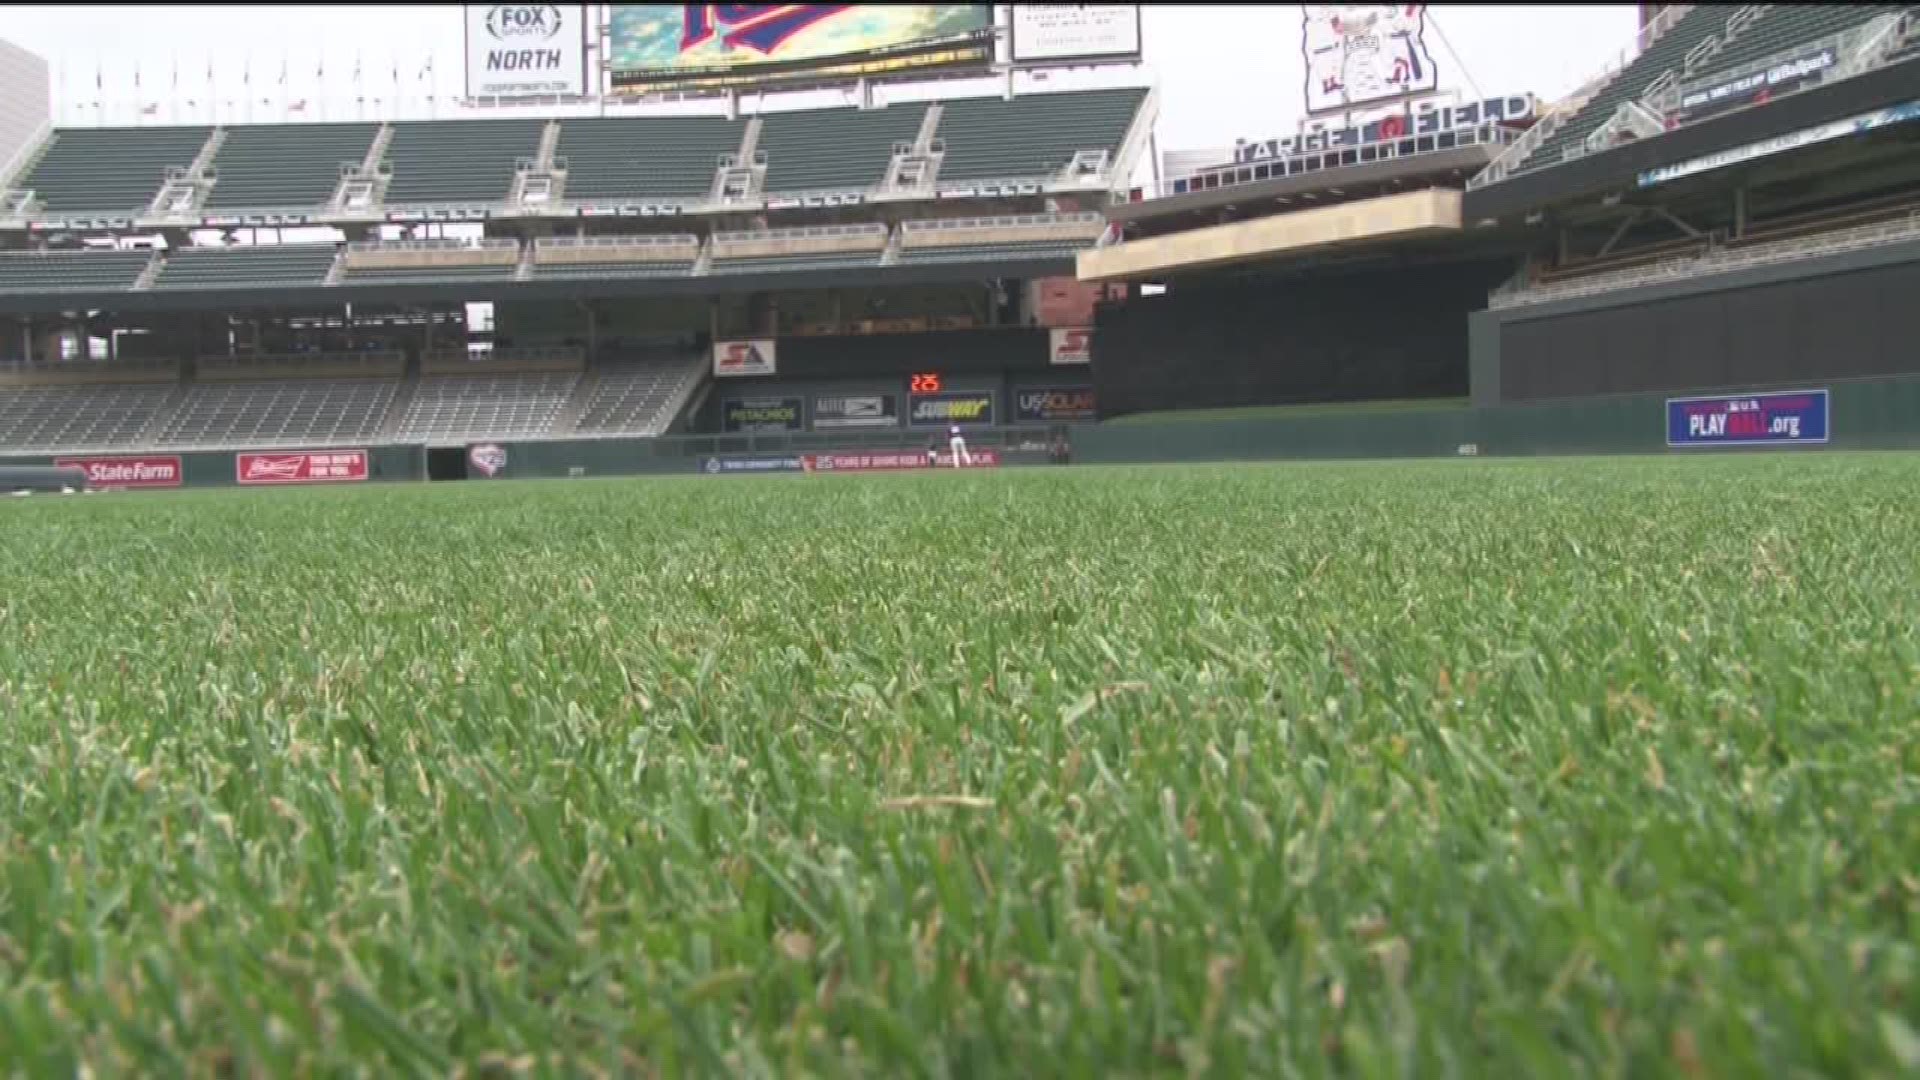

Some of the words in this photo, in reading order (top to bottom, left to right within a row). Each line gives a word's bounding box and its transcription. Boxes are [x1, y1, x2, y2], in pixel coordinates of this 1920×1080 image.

[502, 7, 545, 26] FOX
[502, 27, 548, 36] SPORTS
[487, 49, 562, 71] NORTH
[1232, 121, 1370, 163] TARGET
[1411, 94, 1534, 138] FIELD
[913, 398, 989, 419] SUBWAY
[90, 460, 174, 482] StateFarm
